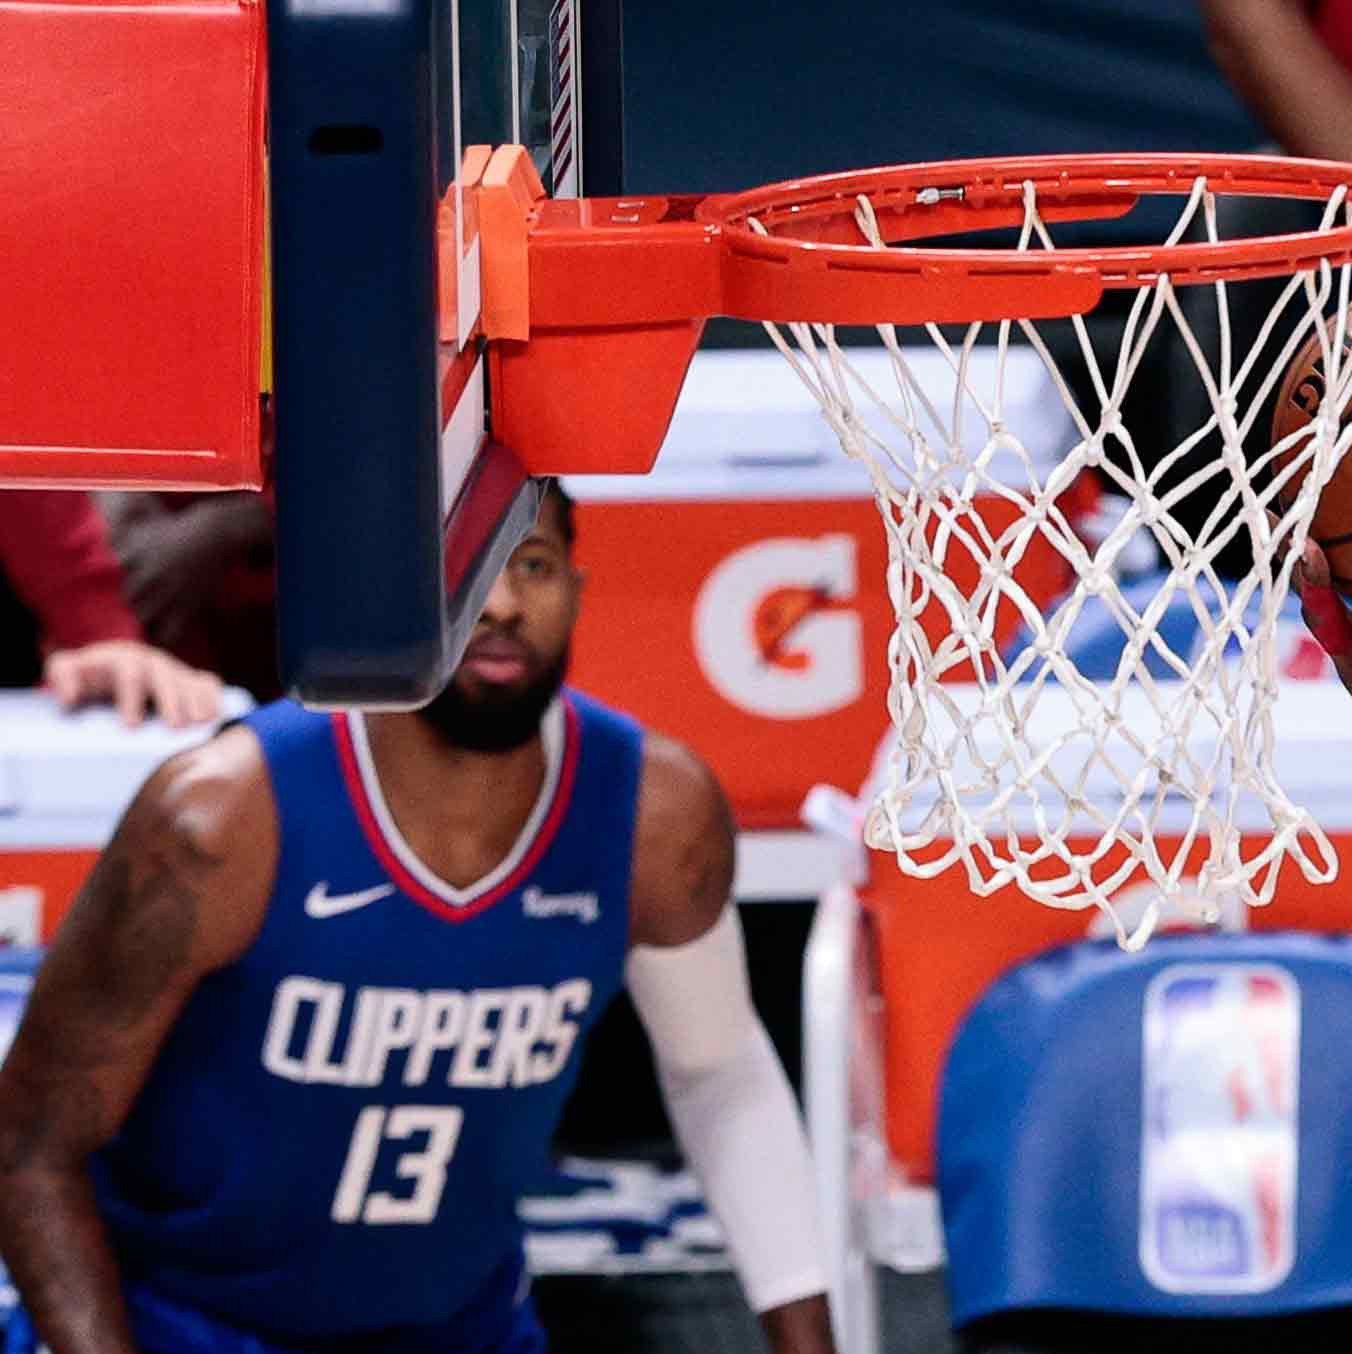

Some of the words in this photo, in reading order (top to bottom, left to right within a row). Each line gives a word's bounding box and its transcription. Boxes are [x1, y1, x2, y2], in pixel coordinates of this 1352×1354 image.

[693, 534, 864, 719] G
[262, 976, 592, 1088] CLIPPERS
[331, 1104, 464, 1225] 13
